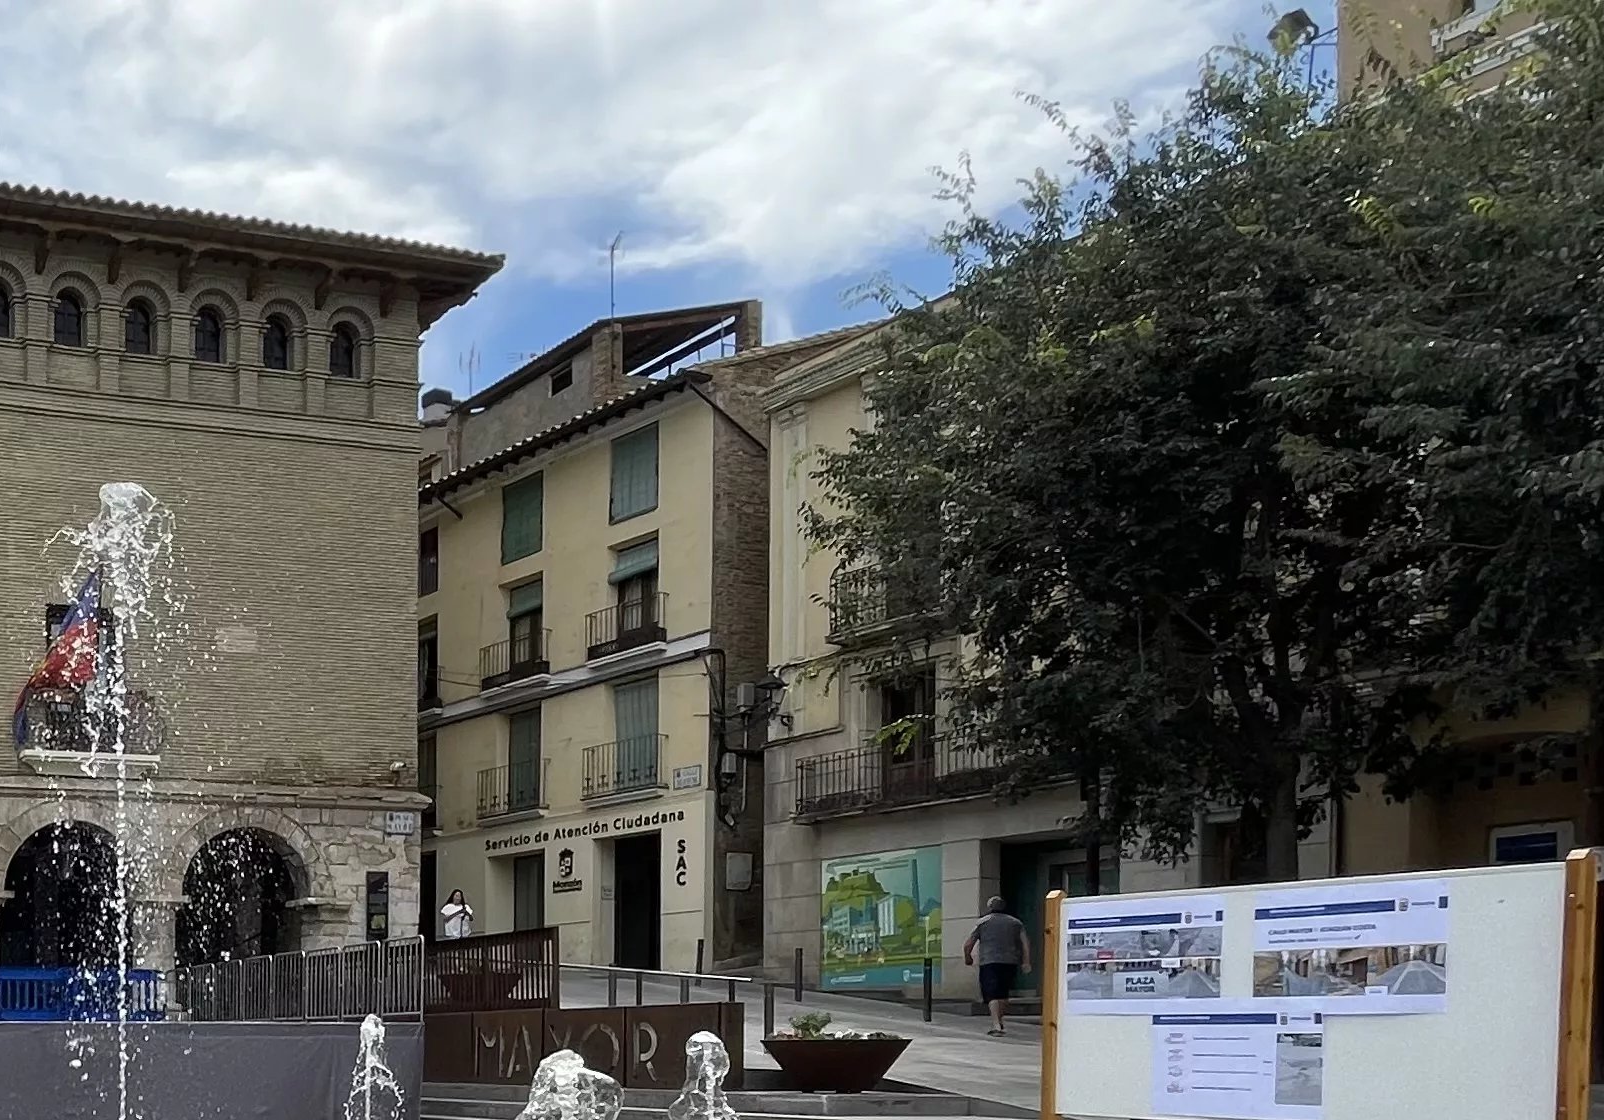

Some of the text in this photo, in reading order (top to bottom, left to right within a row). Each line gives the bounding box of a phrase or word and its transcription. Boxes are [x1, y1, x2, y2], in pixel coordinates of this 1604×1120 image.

[484, 810, 685, 851] Servicio de Atención Ciudadana
[676, 839, 687, 886] SAC
[1126, 977, 1156, 985] PLAZA
